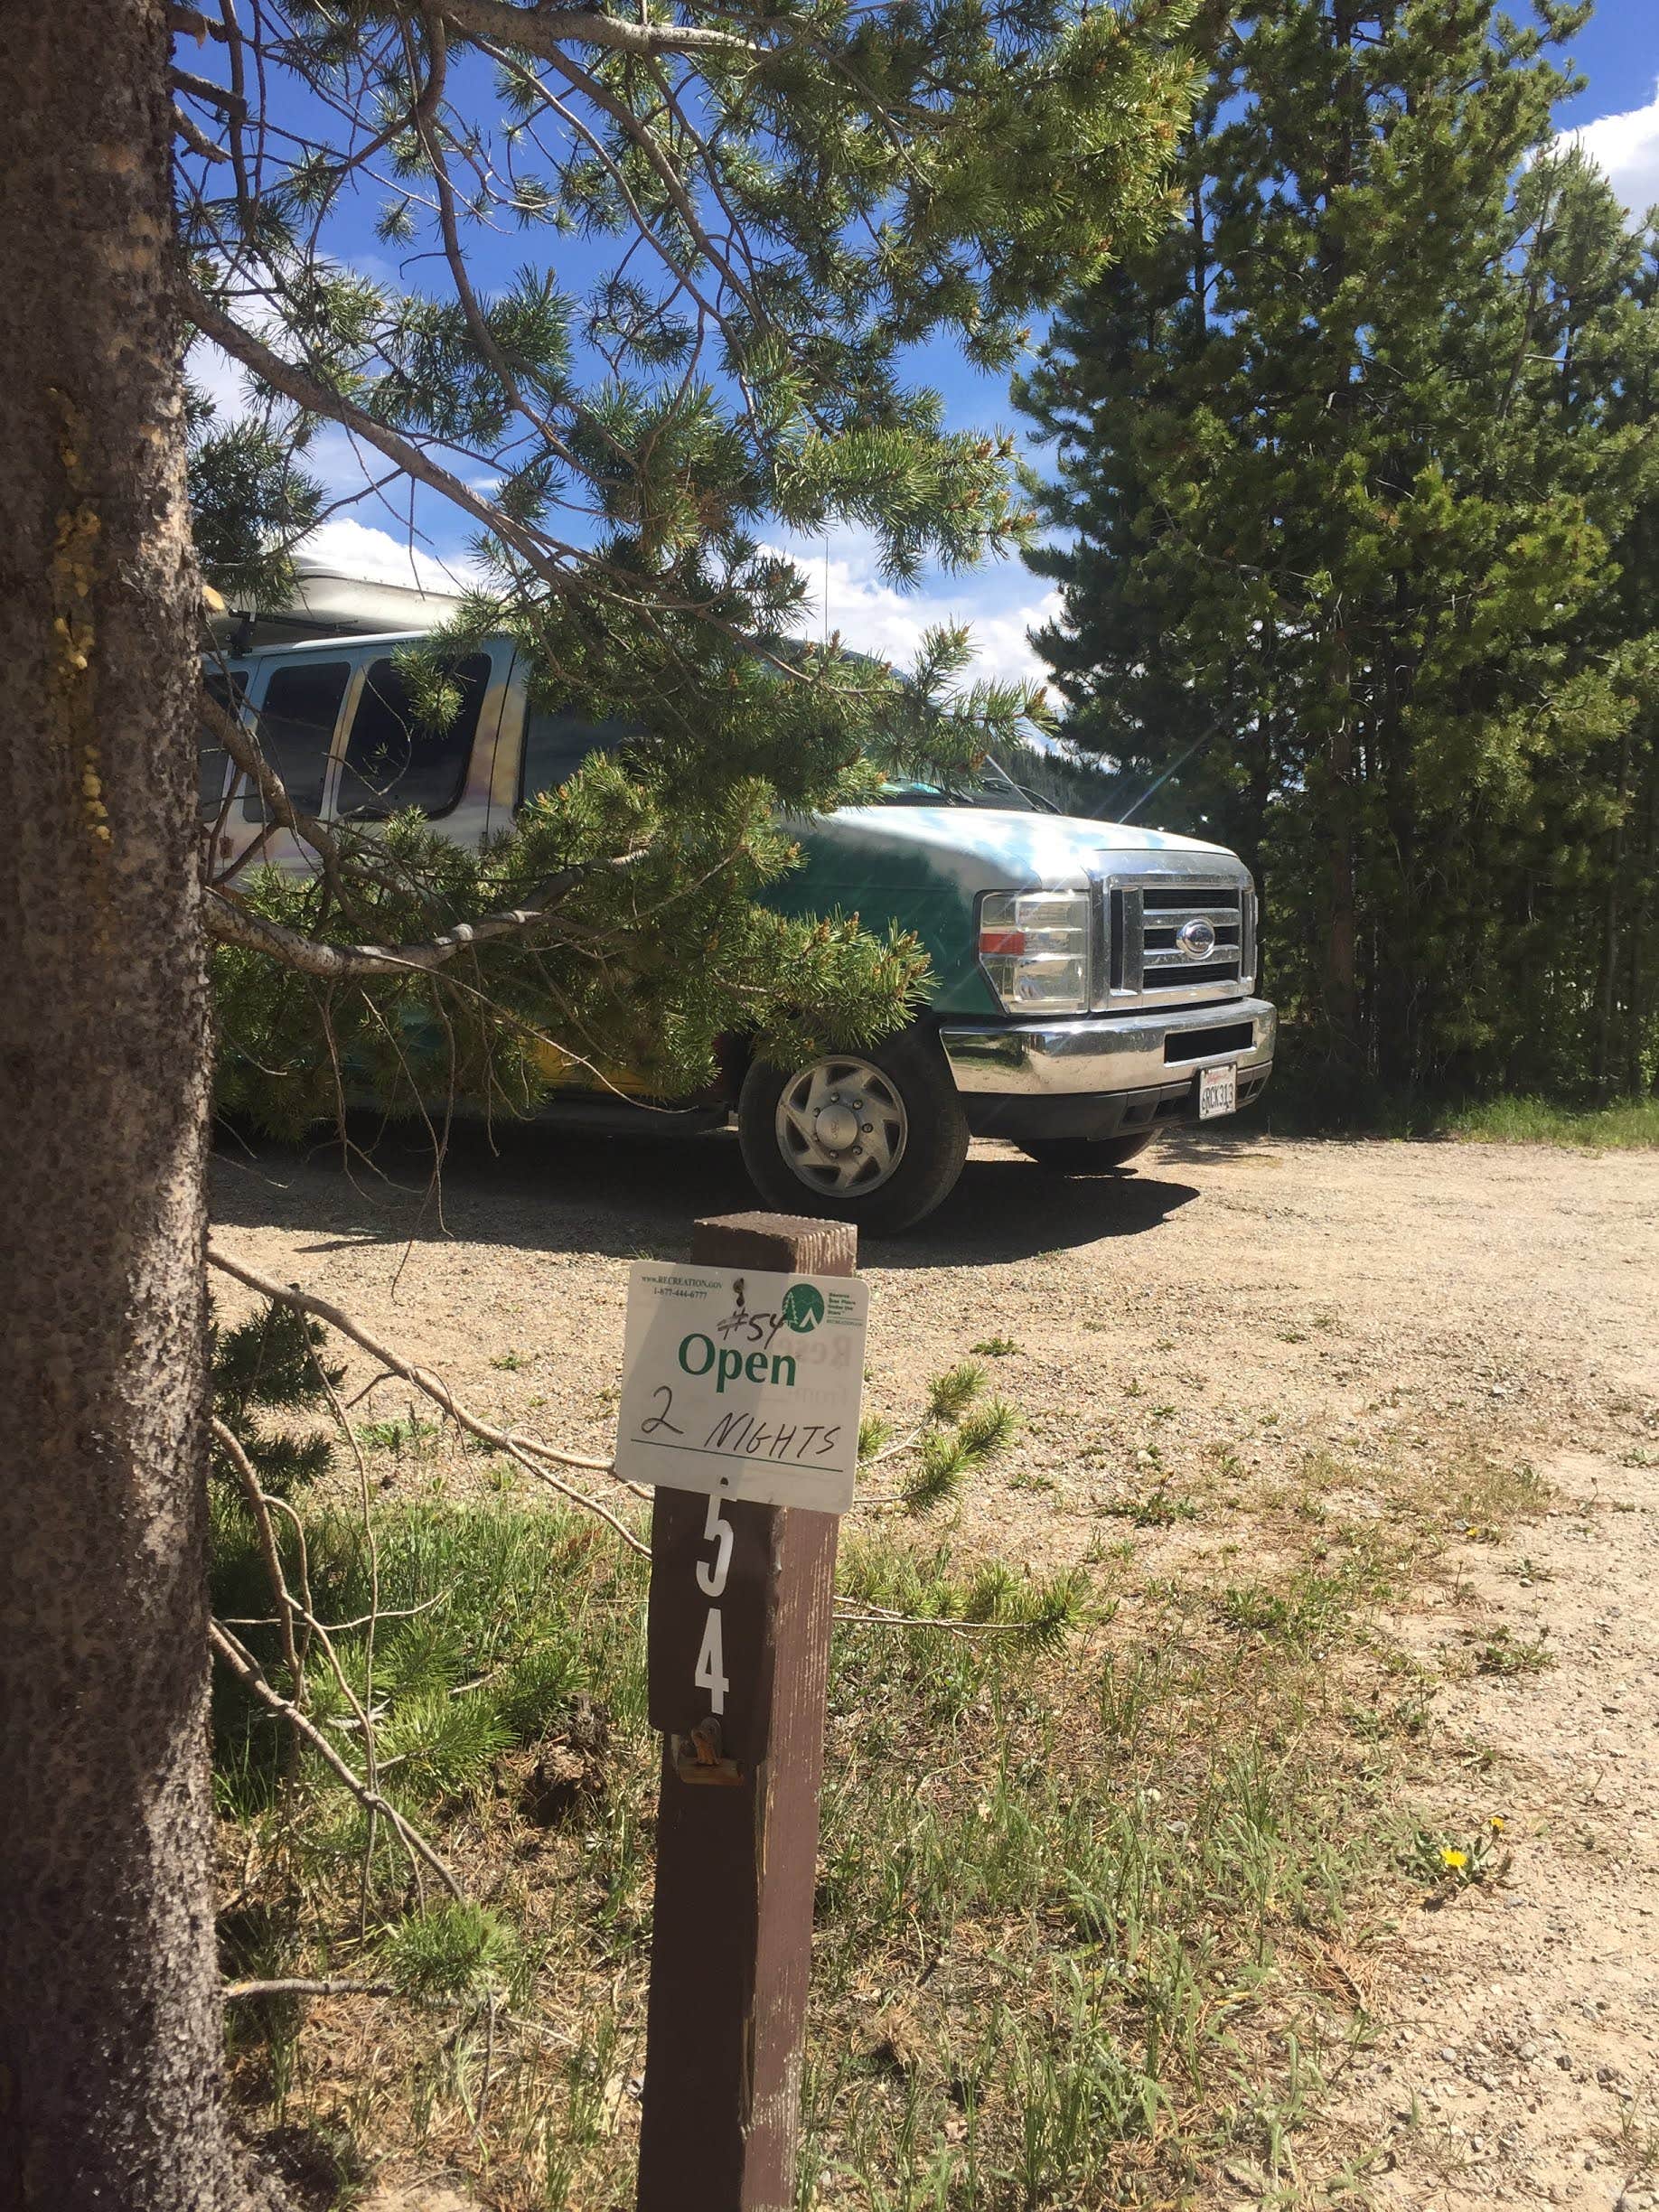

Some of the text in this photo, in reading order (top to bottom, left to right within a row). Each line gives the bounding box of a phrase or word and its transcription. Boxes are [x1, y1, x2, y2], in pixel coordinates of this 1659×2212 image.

[717, 1306, 786, 1349] #54
[678, 1333, 797, 1393] Open
[641, 1385, 841, 1458] 2 NIGHTS
